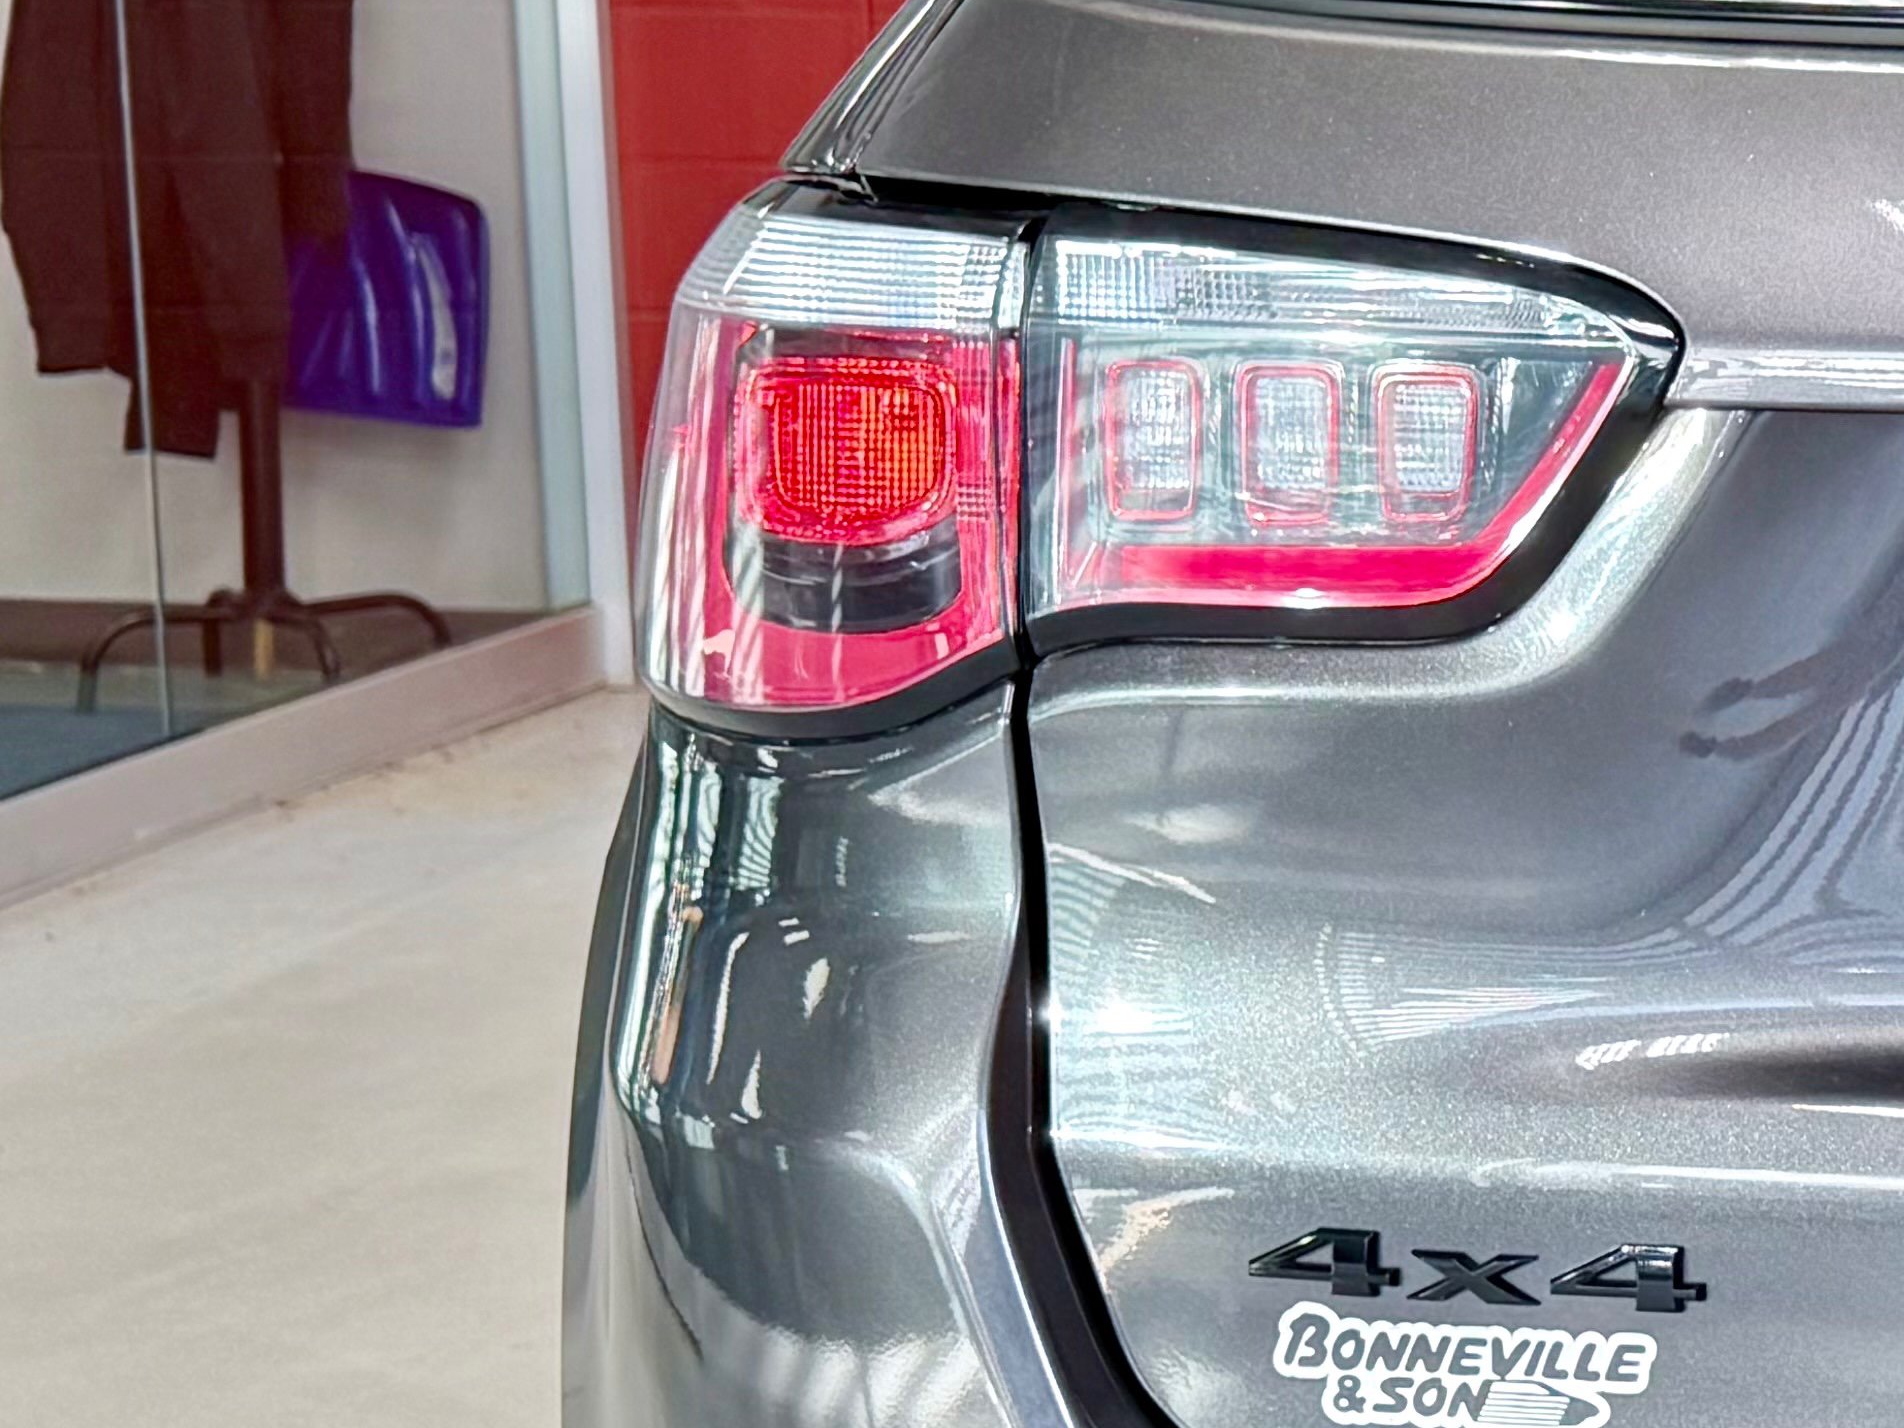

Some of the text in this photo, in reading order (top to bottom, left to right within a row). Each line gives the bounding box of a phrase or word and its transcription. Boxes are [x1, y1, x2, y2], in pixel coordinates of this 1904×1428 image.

[1248, 1227, 1708, 1313] 4x4
[1278, 1310, 1650, 1384] BONNEVILLE
[1332, 1373, 1492, 1420] & SON
